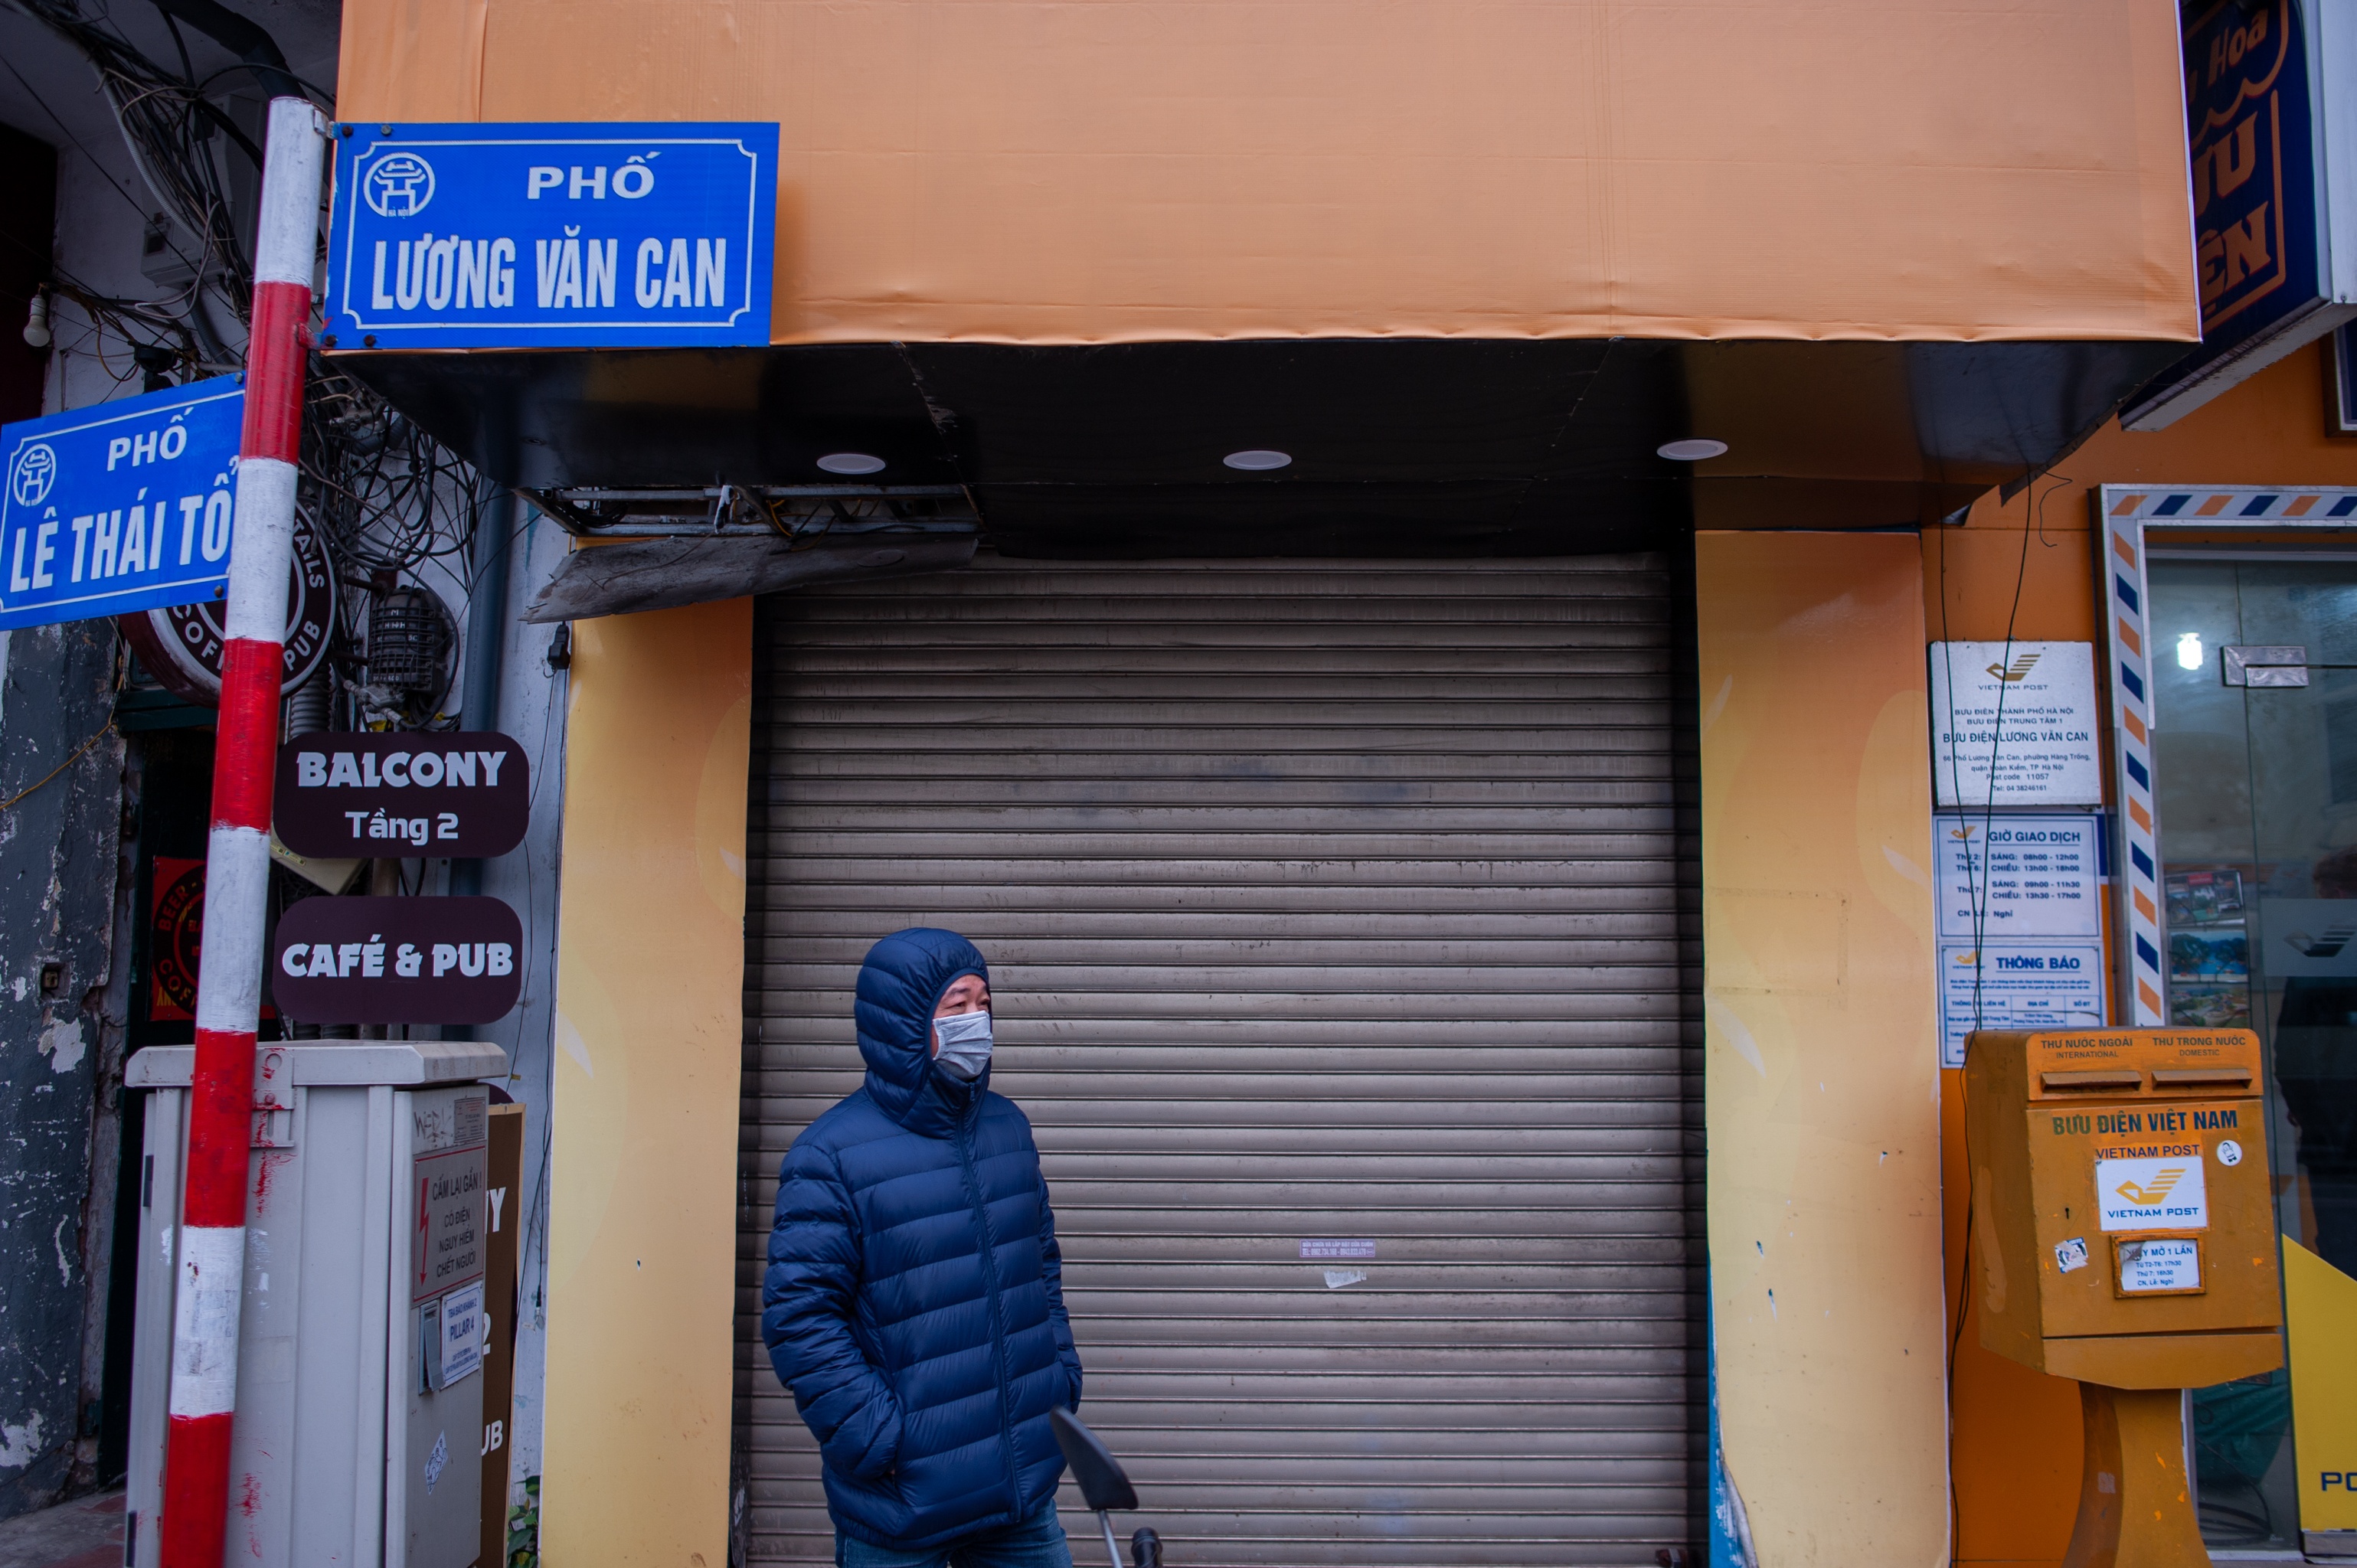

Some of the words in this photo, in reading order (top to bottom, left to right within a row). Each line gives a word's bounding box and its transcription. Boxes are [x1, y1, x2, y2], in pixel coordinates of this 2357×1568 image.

[527, 152, 661, 199] PHỐ
[371, 231, 517, 310] LƯƠNG
[536, 225, 619, 309] VĂN
[636, 237, 727, 308] CAN
[106, 407, 192, 472] PHỐ
[10, 506, 58, 593] LÊ
[70, 485, 167, 583] THÁI
[179, 457, 240, 566] TỔ
[283, 620, 321, 671] PUB
[2027, 707, 2045, 715] PHỐ
[2060, 707, 2074, 715] NỘI
[1943, 732, 1966, 743] BƯU
[1970, 730, 1996, 744] ĐIỆN
[1999, 730, 2038, 742] LƯƠNG
[2042, 730, 2064, 741] VĂN
[2066, 732, 2089, 741] CAN
[2051, 753, 2068, 763] Hàng
[296, 751, 507, 788] BALCONY
[345, 807, 430, 846] Tầng
[437, 812, 459, 840] 2
[1989, 829, 2012, 841] GIỜ
[2015, 831, 2046, 841] GIAO
[2050, 831, 2081, 844] DỊCH
[1991, 852, 2018, 861] SÁNG:
[1992, 880, 2019, 888] SÁNG:
[158, 884, 190, 932] BEER
[282, 933, 386, 978] CAFÉ
[395, 944, 423, 977] &
[431, 942, 514, 977] PUB
[1996, 955, 2044, 969] THÔNG
[2050, 955, 2080, 969] BÁO
[2042, 1039, 2062, 1048] THƯ
[2065, 1036, 2096, 1048] NƯỚC
[2098, 1036, 2133, 1047] NGOÀI
[2153, 1037, 2174, 1047] THƯ
[2176, 1037, 2213, 1047] TRONG
[2216, 1034, 2247, 1046] NƯỚC
[2056, 1050, 2119, 1059] INTERNATIONAL
[2052, 1116, 2091, 1135] BƯU
[2097, 1110, 2143, 1137] ĐIỆN
[2149, 1109, 2188, 1135] VIỆT
[2194, 1110, 2238, 1130] NAM
[2096, 1146, 2159, 1159] VIETNAM
[2163, 1145, 2200, 1157] POST
[433, 1173, 449, 1200] CẤM
[450, 1177, 462, 1200] LẠI
[2107, 1207, 2162, 1218] VIETNAM
[2167, 1207, 2199, 1217] POST
[440, 1233, 458, 1253] NGUY
[2168, 1247, 2172, 1256] 1
[436, 1255, 455, 1278] CHẾT
[449, 1317, 470, 1342] PILLAR
[471, 1315, 475, 1331] 4
